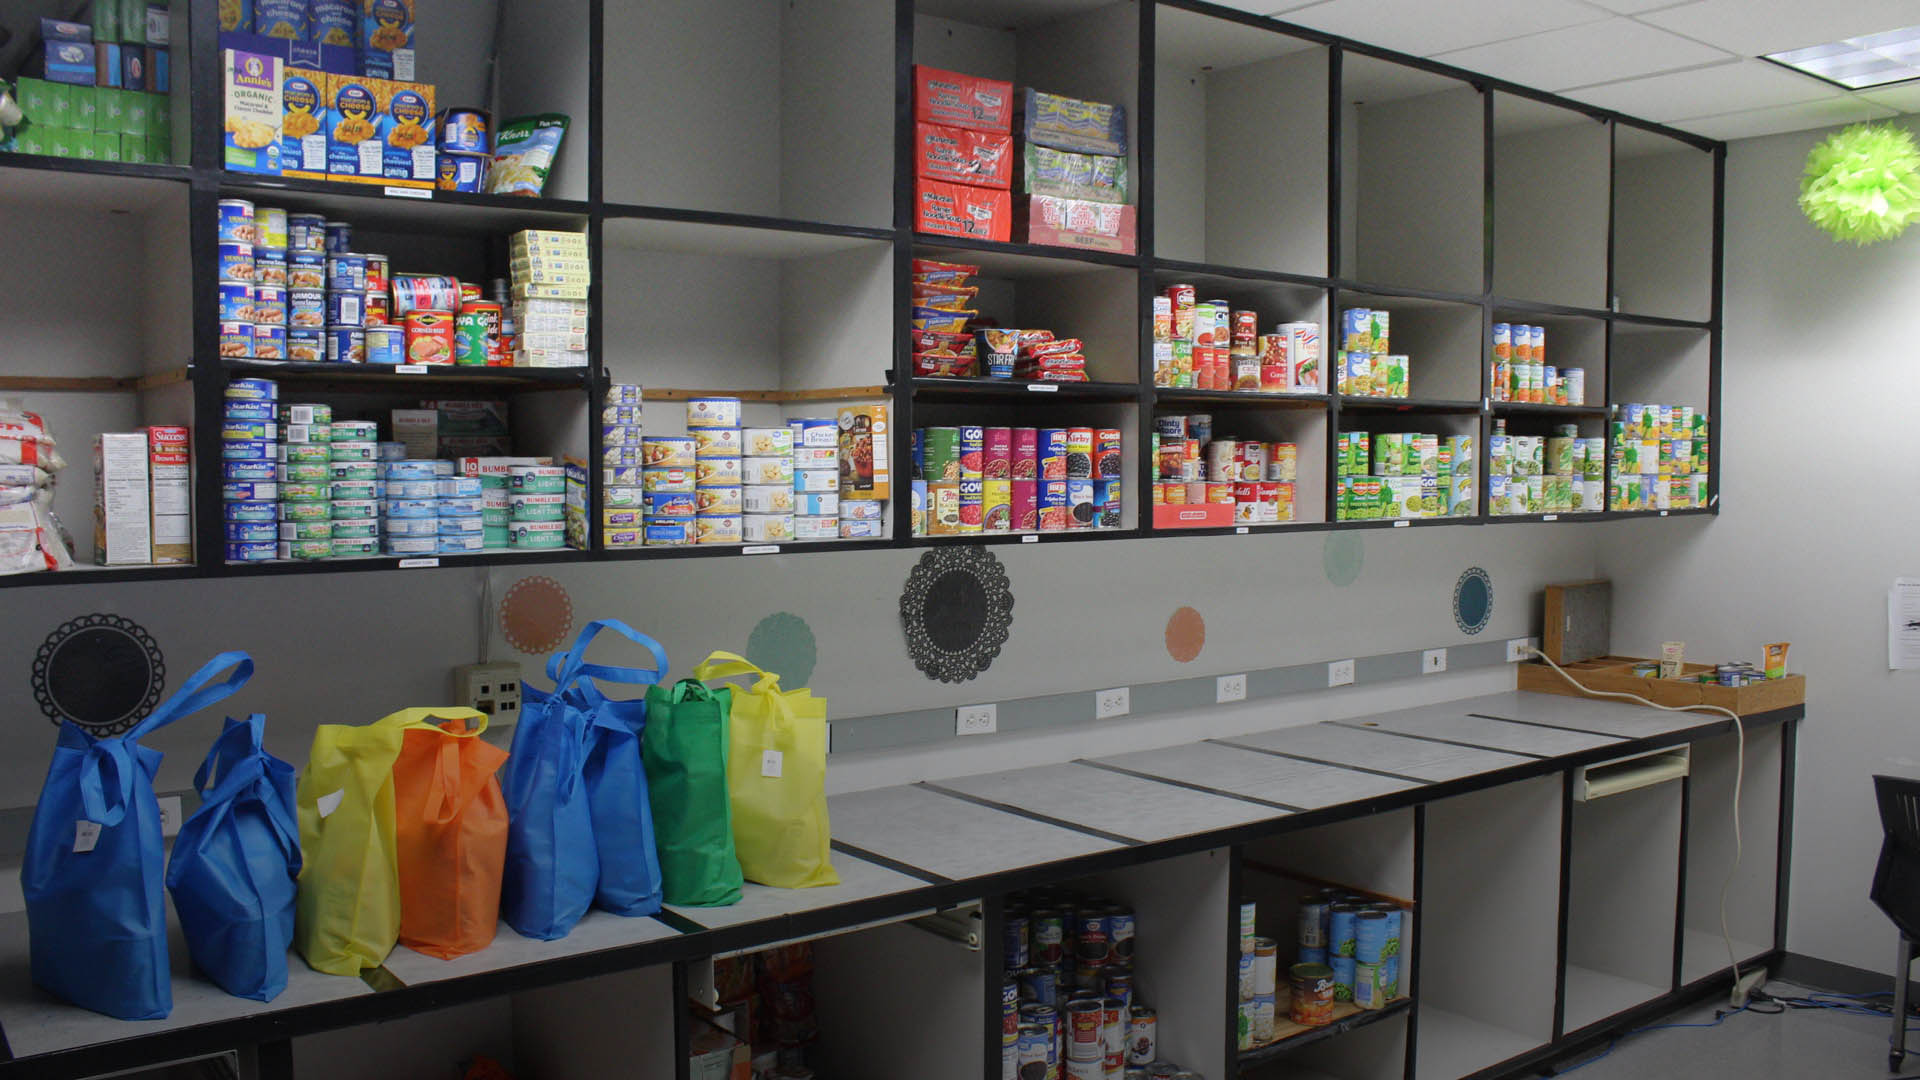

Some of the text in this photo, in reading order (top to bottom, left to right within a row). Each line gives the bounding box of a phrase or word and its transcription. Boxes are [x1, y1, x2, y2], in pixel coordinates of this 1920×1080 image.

[237, 73, 272, 89] Annie's
[234, 90, 273, 103] ORGANIC
[501, 128, 530, 141] Knorr
[962, 219, 975, 233] 12
[988, 354, 1005, 365] STIR
[155, 432, 185, 441] Success
[1068, 432, 1090, 443] Kirby
[960, 482, 982, 492] GOY
